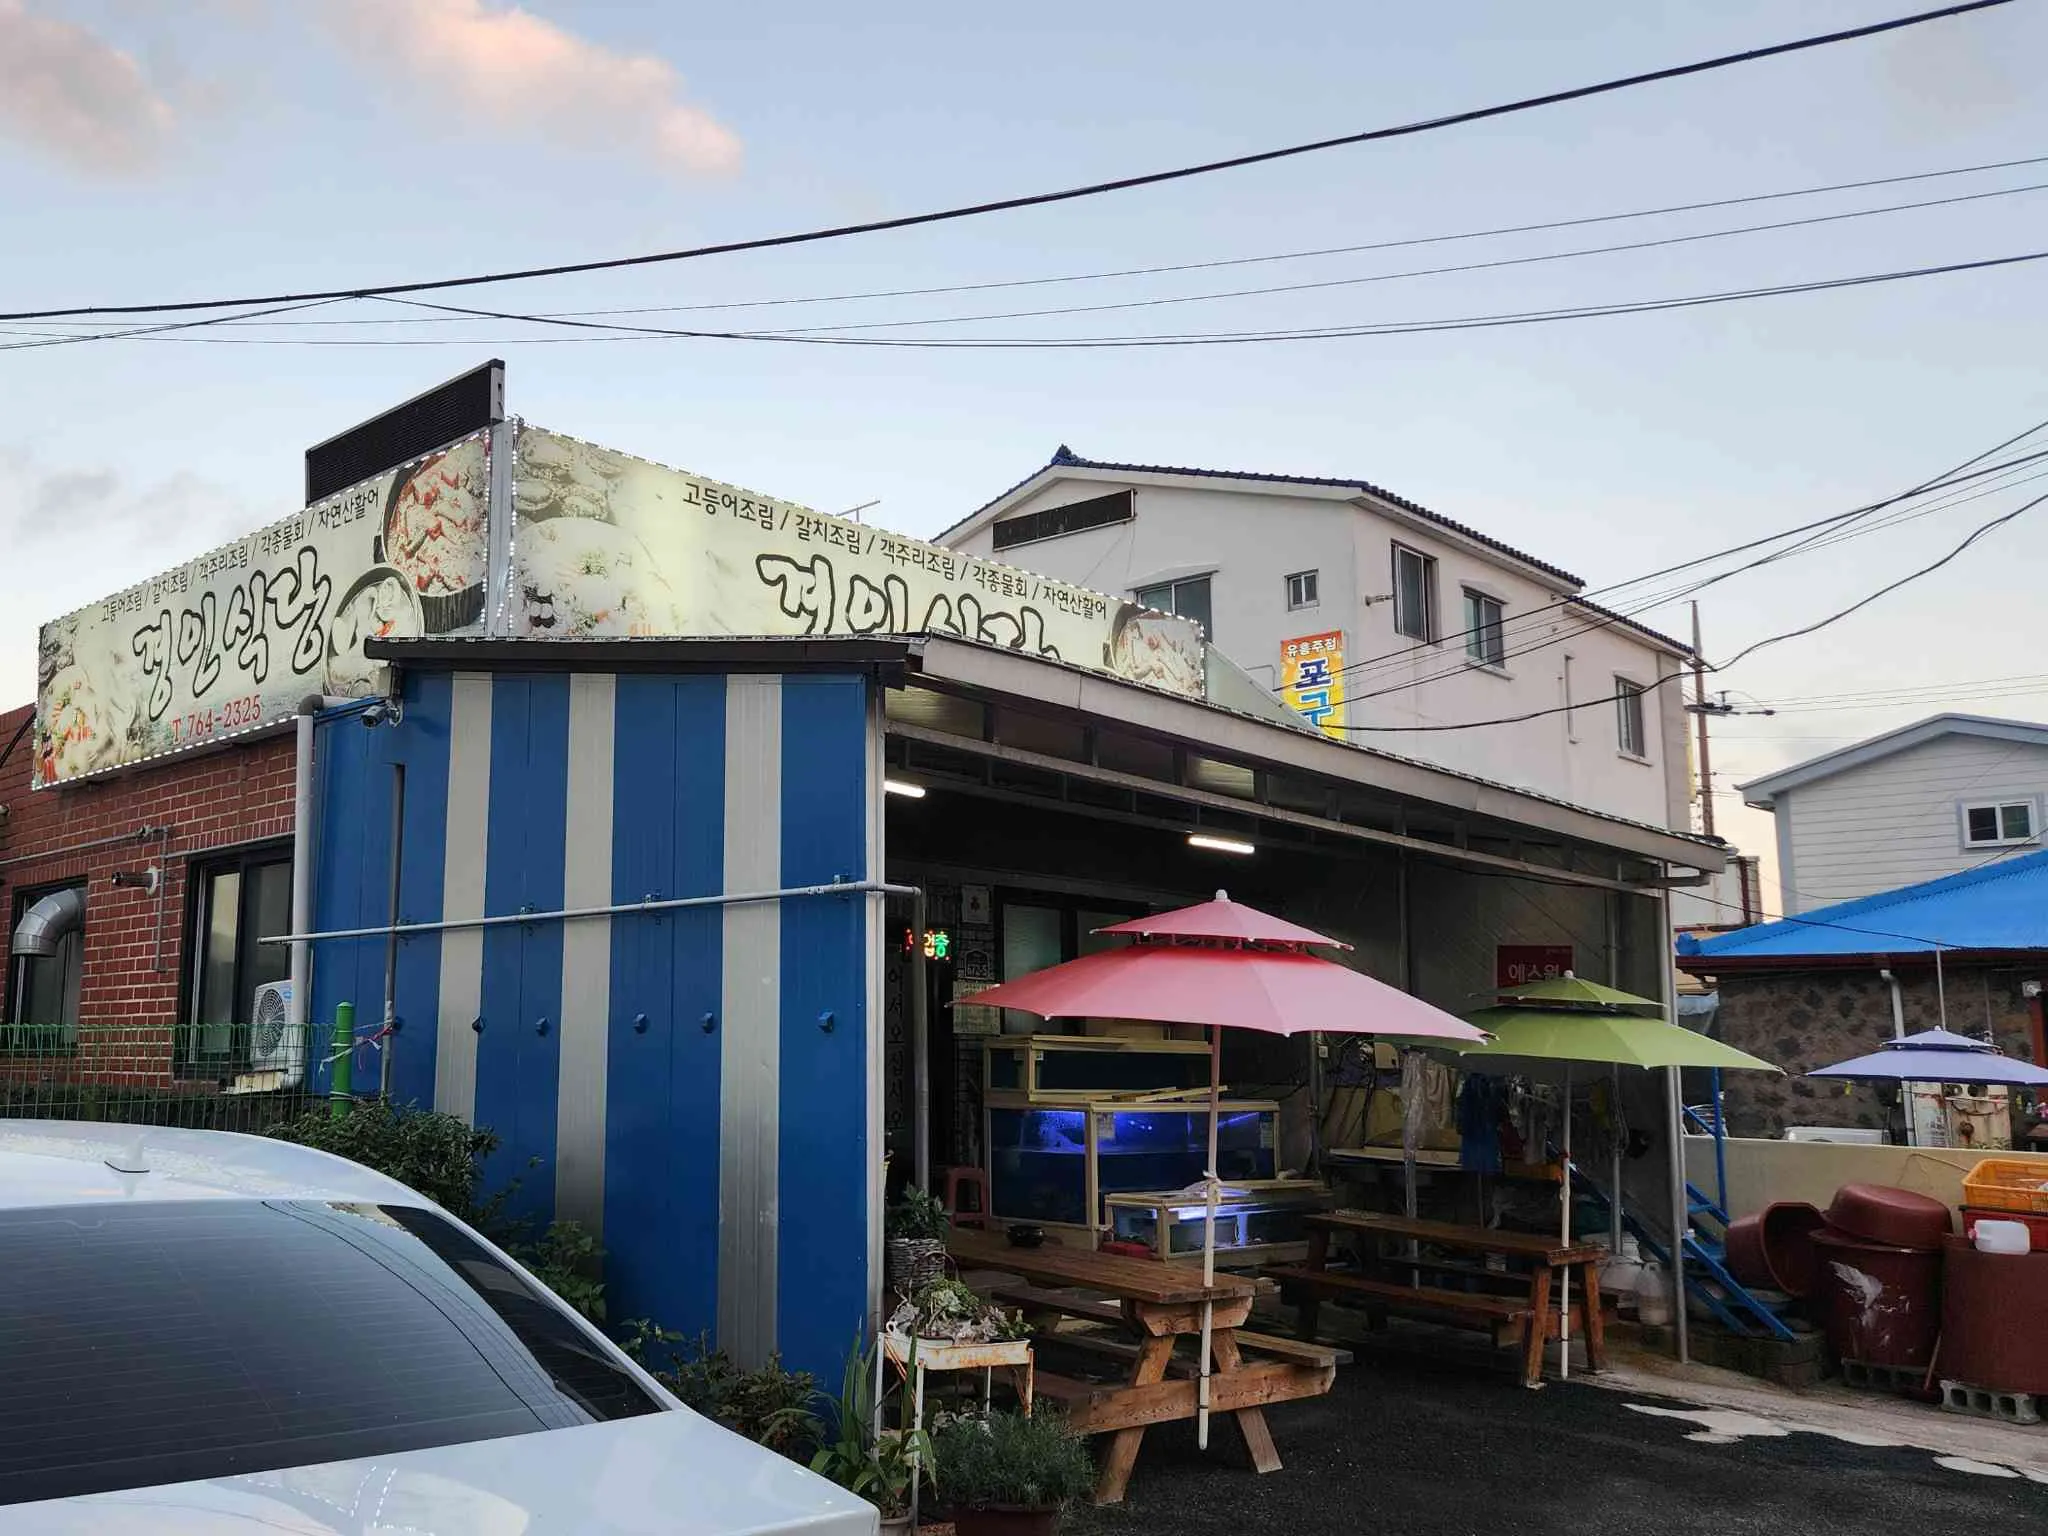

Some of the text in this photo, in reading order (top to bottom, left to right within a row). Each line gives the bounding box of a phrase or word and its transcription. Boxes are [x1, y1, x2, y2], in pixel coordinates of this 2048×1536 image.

[101, 586, 143, 622] 고등어조림
[152, 570, 188, 605] 갈치조림
[199, 543, 249, 585] 객주리조림
[261, 519, 305, 557] 각종물회
[318, 486, 380, 529] 자연산활어
[682, 482, 774, 529] 고등어조림
[796, 513, 861, 555] 갈치조림
[880, 538, 956, 580] 객주리조림
[972, 566, 1028, 599] 각종물회
[1043, 587, 1107, 620] 자연산활어
[132, 545, 331, 722] 경민식당
[172, 694, 261, 742] T.764-2325
